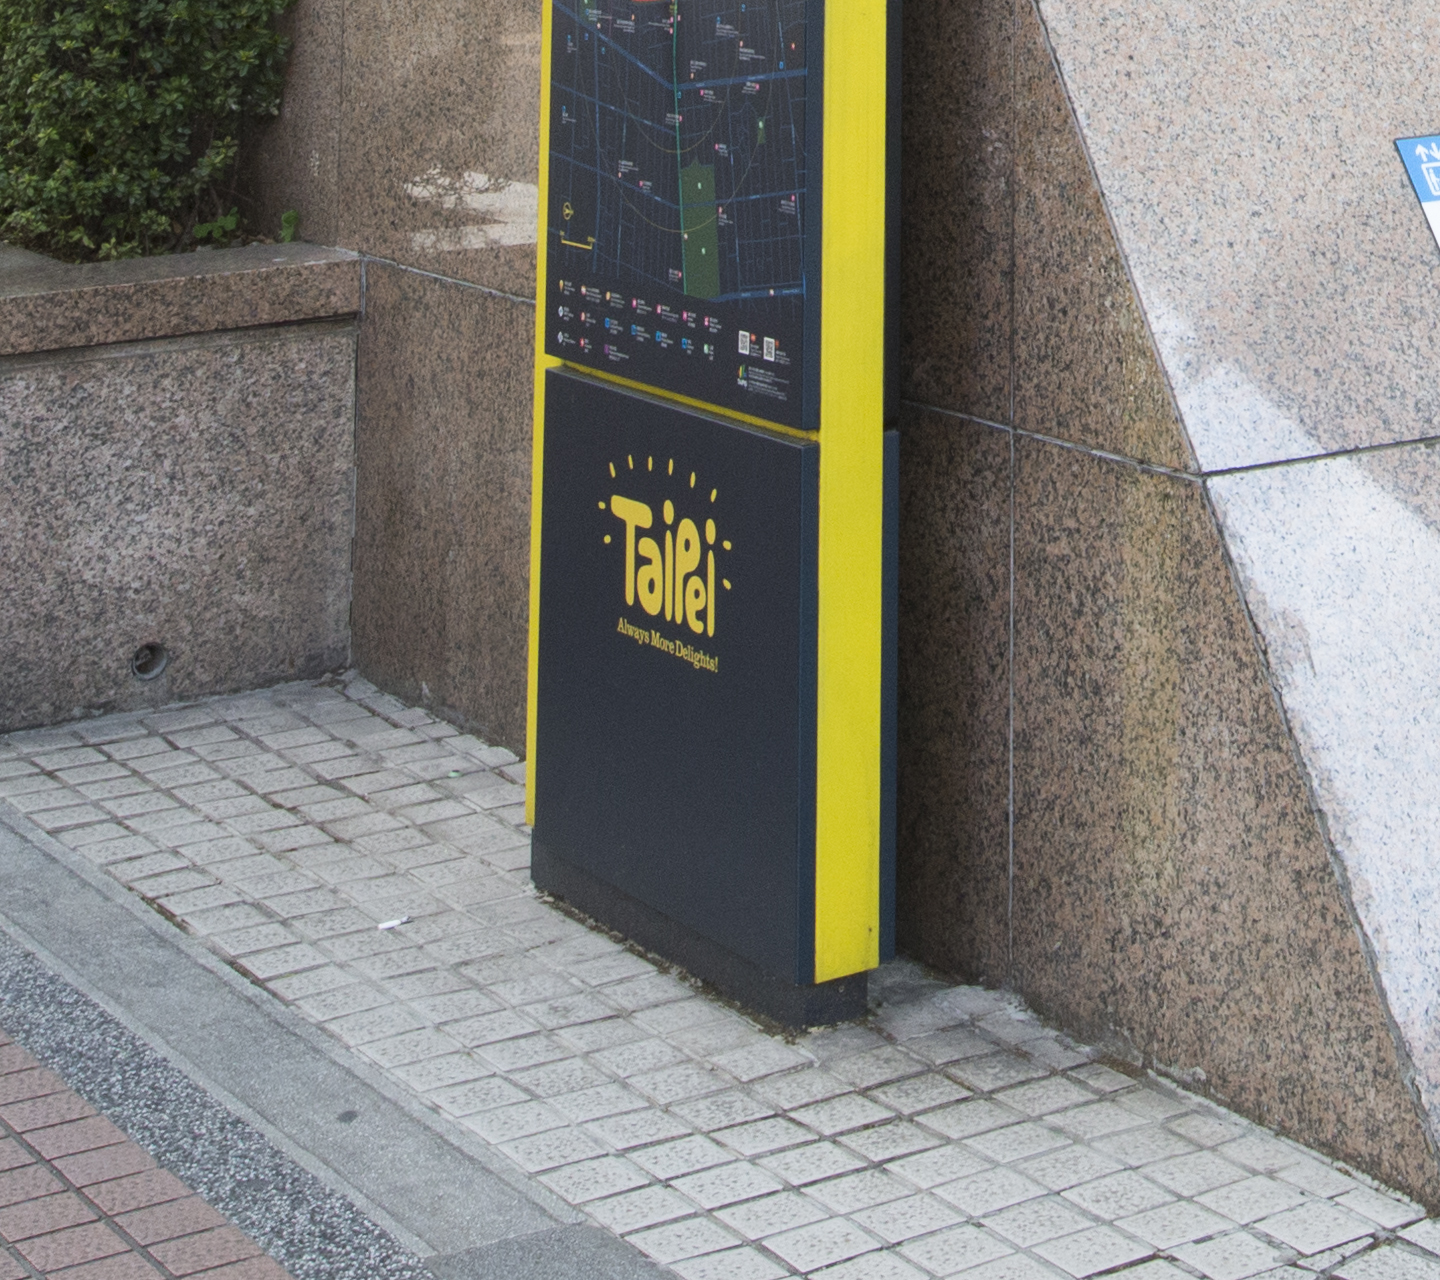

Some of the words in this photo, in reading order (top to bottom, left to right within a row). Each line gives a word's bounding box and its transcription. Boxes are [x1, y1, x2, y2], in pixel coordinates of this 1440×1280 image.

[617, 617, 649, 644] Always
[650, 629, 675, 655] More
[675, 640, 719, 673] Delights!
